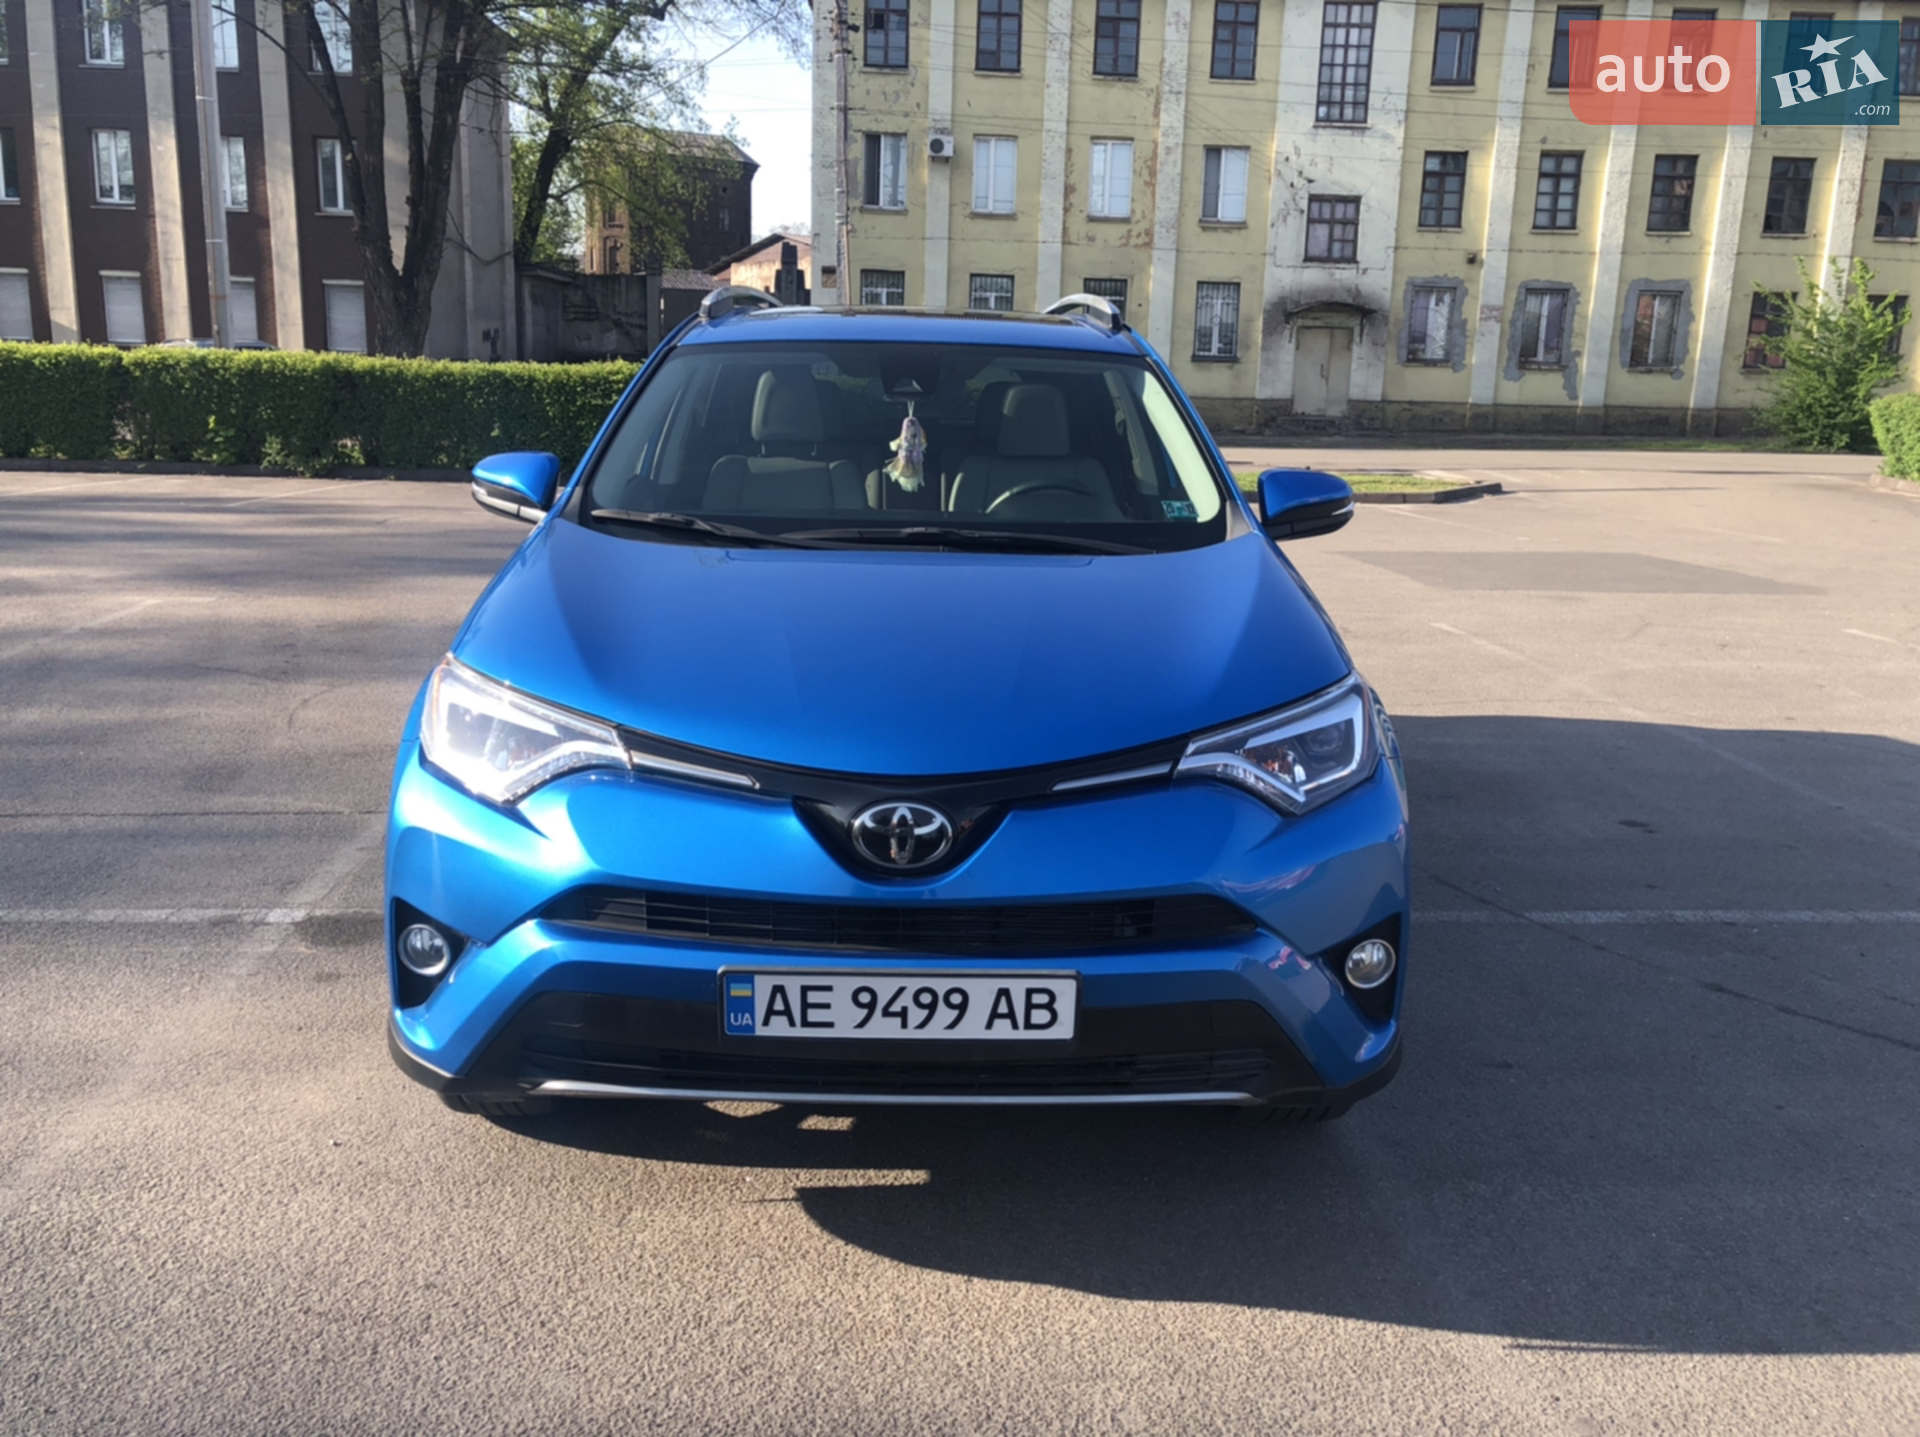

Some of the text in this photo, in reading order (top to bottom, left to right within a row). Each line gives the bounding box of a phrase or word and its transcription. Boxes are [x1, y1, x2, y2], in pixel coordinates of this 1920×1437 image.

[730, 1012, 753, 1027] UA
[761, 984, 1059, 1030] AE 9499 AB
